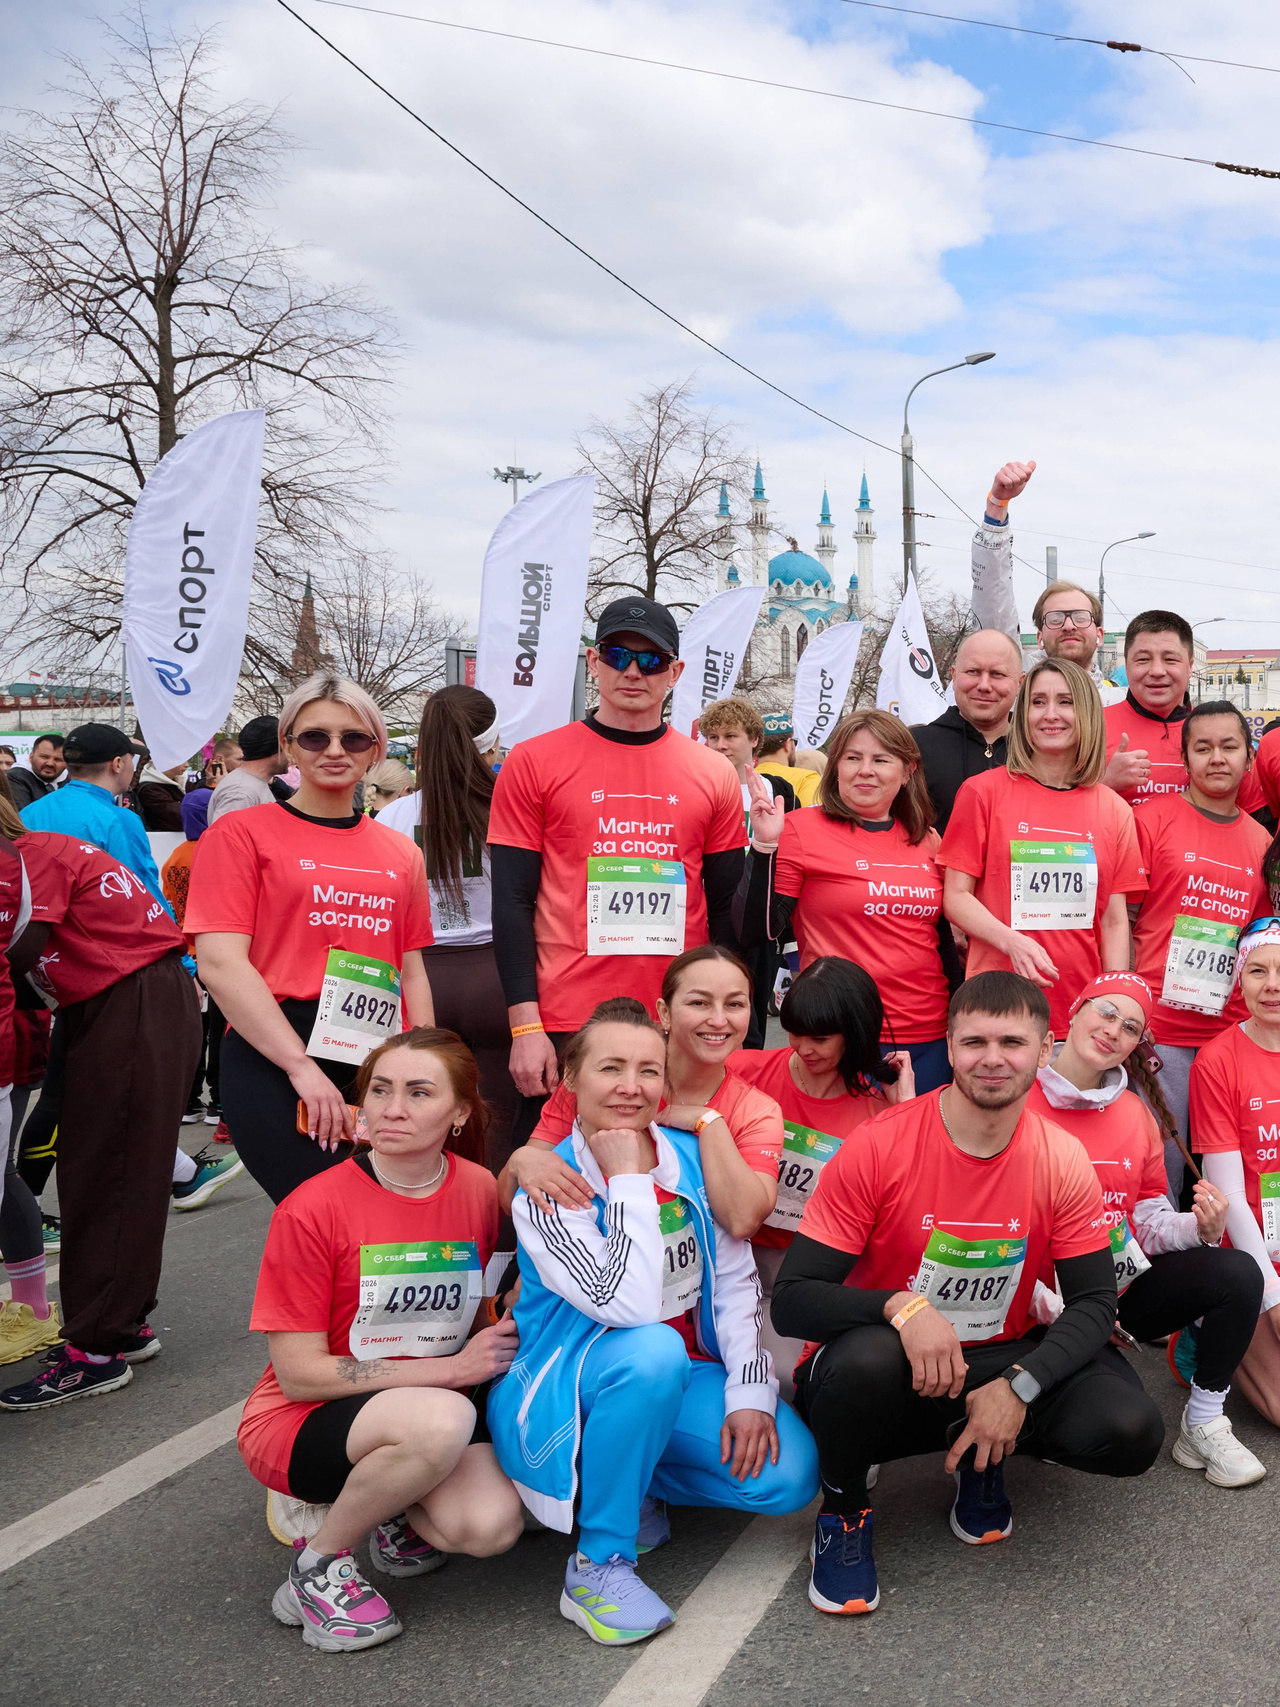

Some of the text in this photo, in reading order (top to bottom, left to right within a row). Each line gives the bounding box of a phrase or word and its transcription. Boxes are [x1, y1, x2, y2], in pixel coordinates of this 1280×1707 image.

[543, 564, 553, 612] СПОРТ
[513, 562, 545, 687] БОЛЬШОЙ
[598, 817, 674, 836] Магнит
[592, 840, 678, 858] за спорт
[868, 881, 936, 899] Магнит
[1029, 872, 1083, 893] 49178
[1187, 875, 1249, 902] Магнит
[313, 884, 395, 911] Магнит
[608, 891, 671, 915] 49197
[1180, 895, 1249, 920] за спорт
[309, 911, 338, 926] за
[864, 903, 938, 918] за спорт
[1184, 948, 1235, 976] 49185
[324, 978, 338, 986] 2026
[1178, 985, 1200, 994] МАГНИТ
[325, 989, 334, 1009] 12:20
[341, 992, 396, 1028] 48927
[331, 1039, 358, 1050] МАГНИТ
[1256, 1147, 1278, 1161] за
[384, 1254, 405, 1262] СБЕР
[947, 1247, 966, 1257] СБЕР
[920, 1261, 936, 1272] 2026
[920, 1273, 931, 1293] 12:20
[936, 1275, 1009, 1301] 49187
[365, 1291, 375, 1313] 12:20
[384, 1283, 462, 1313] 49203
